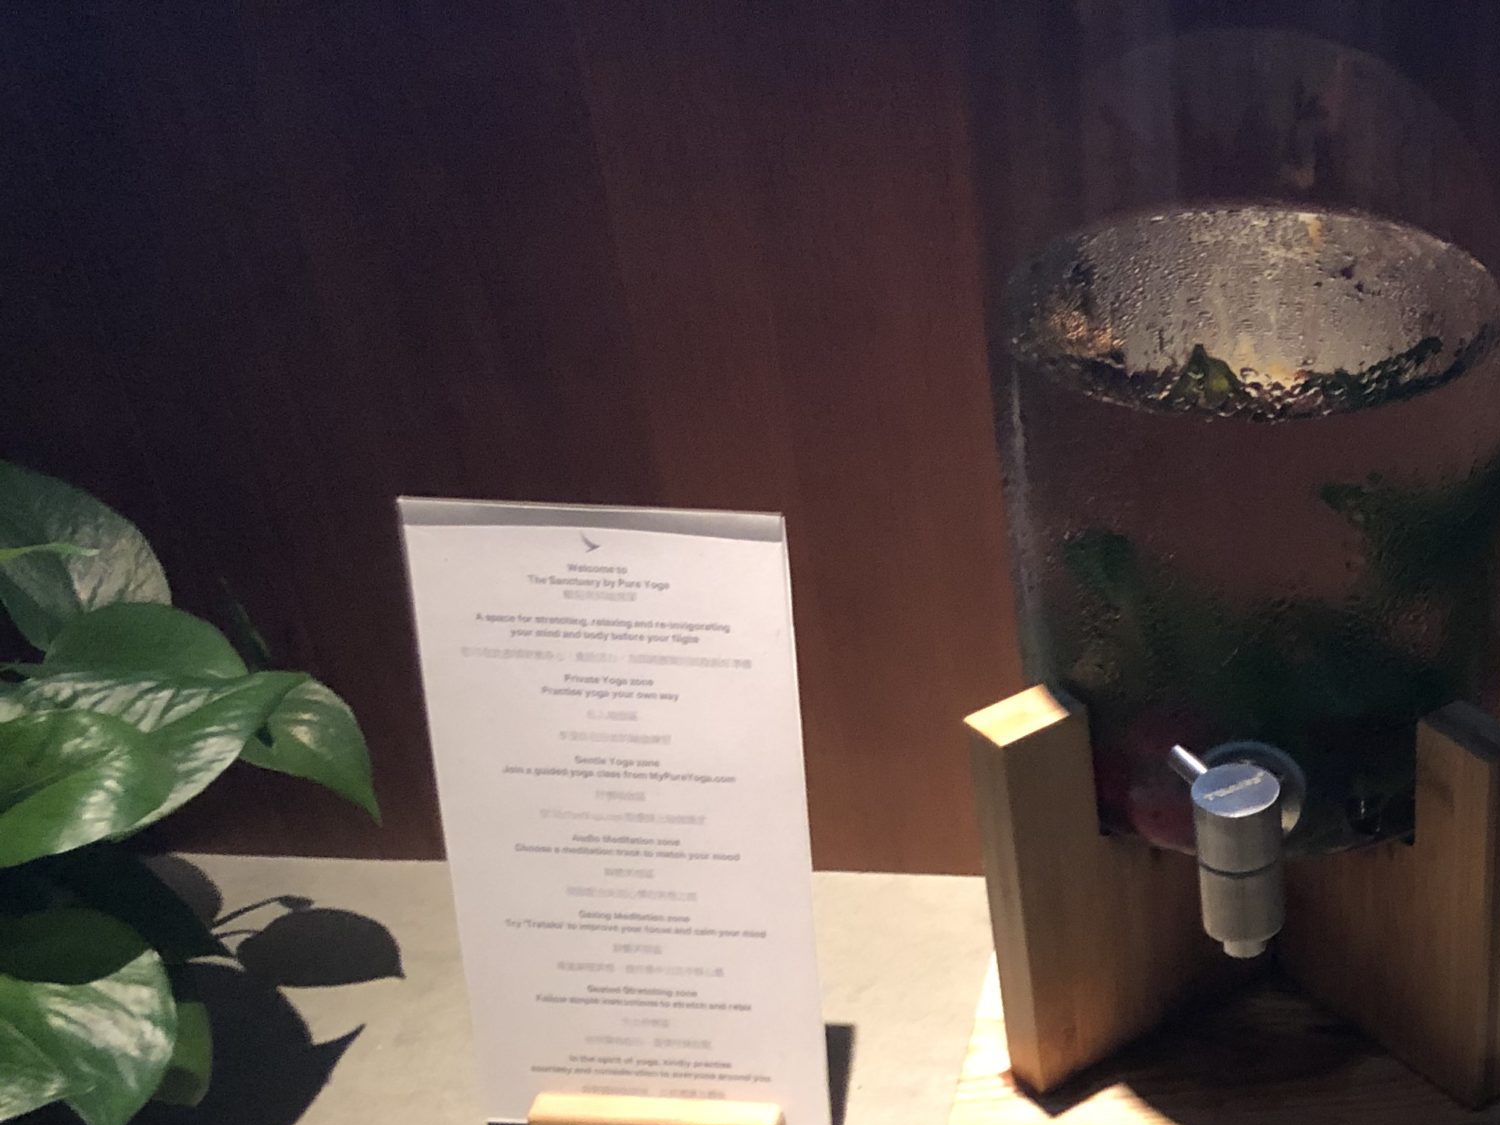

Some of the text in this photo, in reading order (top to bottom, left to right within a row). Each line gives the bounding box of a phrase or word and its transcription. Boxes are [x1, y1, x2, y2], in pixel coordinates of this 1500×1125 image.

[527, 574, 670, 591] The Sanctuary by Pure Yoga
[634, 619, 653, 628] and
[603, 676, 628, 686] Yoga
[610, 758, 634, 768] Yoga
